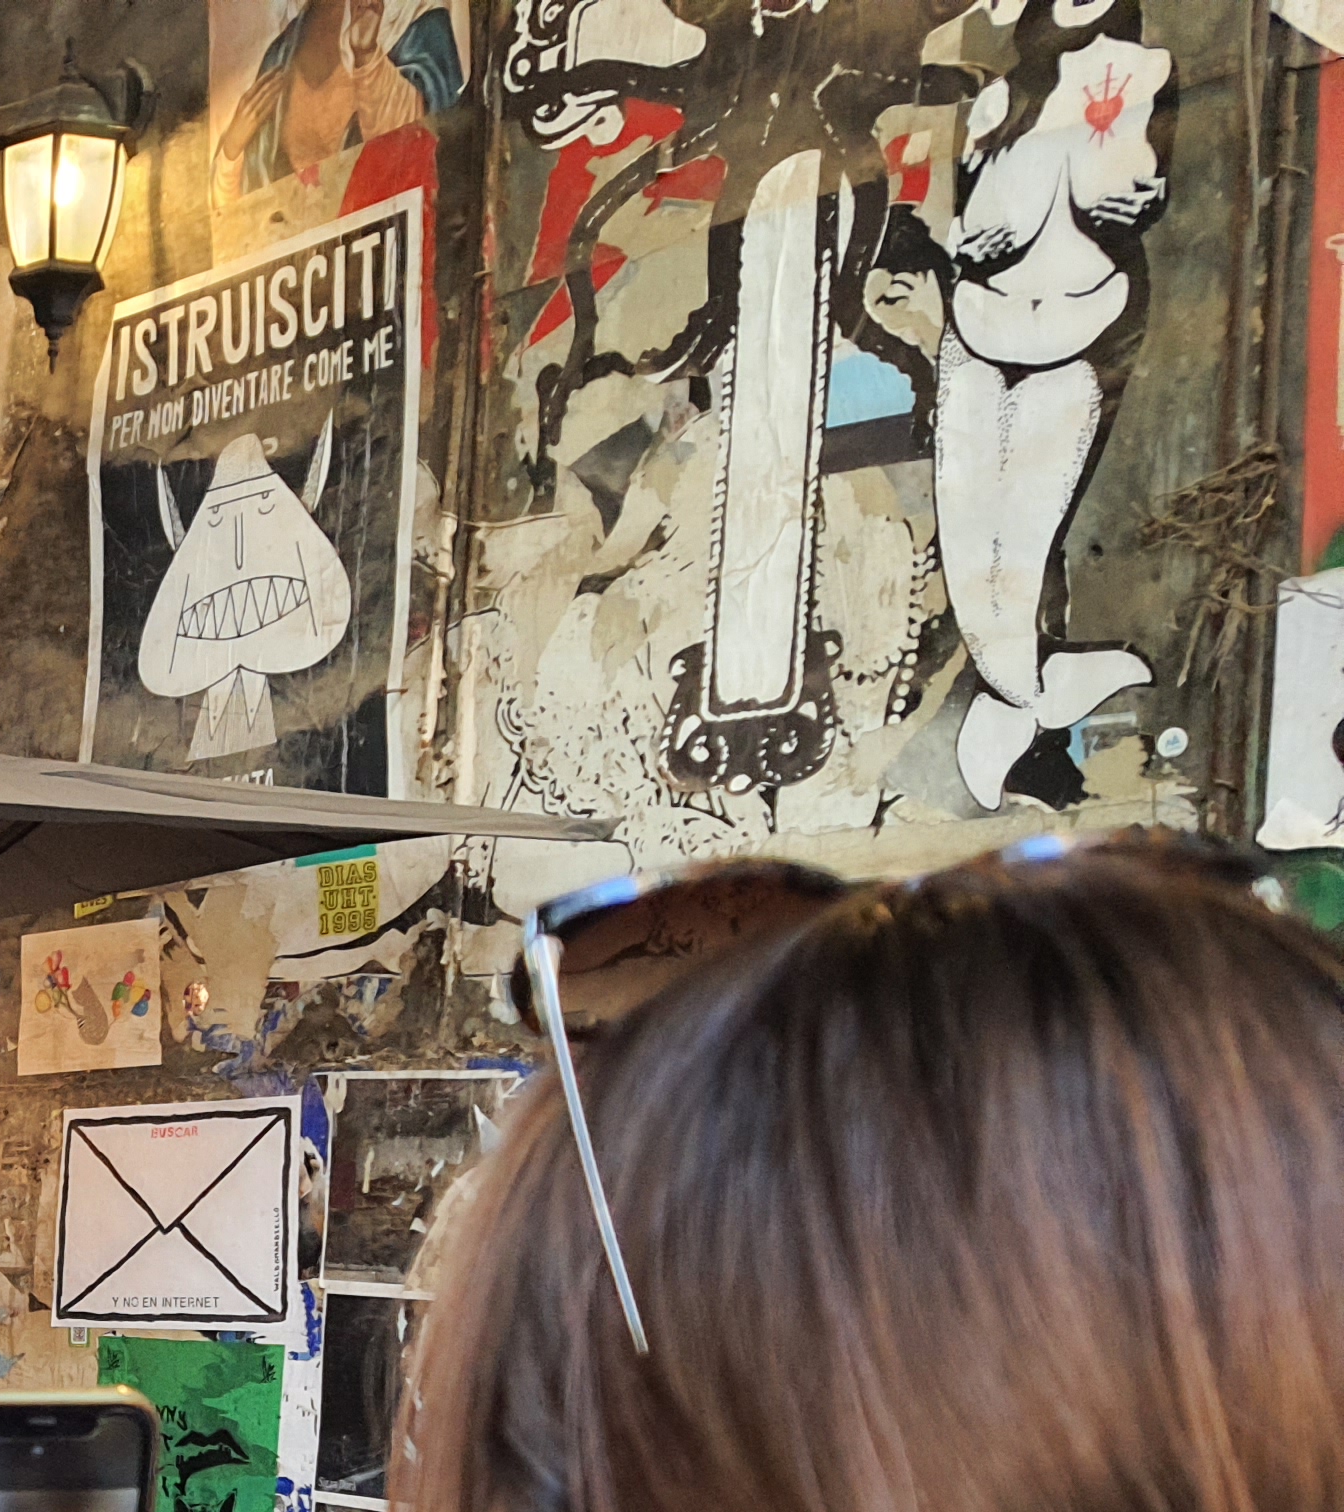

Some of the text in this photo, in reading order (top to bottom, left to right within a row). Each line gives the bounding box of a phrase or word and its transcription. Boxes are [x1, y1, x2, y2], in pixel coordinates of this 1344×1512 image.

[115, 226, 397, 401] ISTRUISCITI
[109, 324, 394, 451] PER NON DIVENTARE COME ME
[318, 861, 377, 888] DIAS
[320, 908, 376, 935] 1995
[150, 1125, 200, 1139] BUSCAR
[112, 1296, 220, 1308] Y NO EN INTERNET
